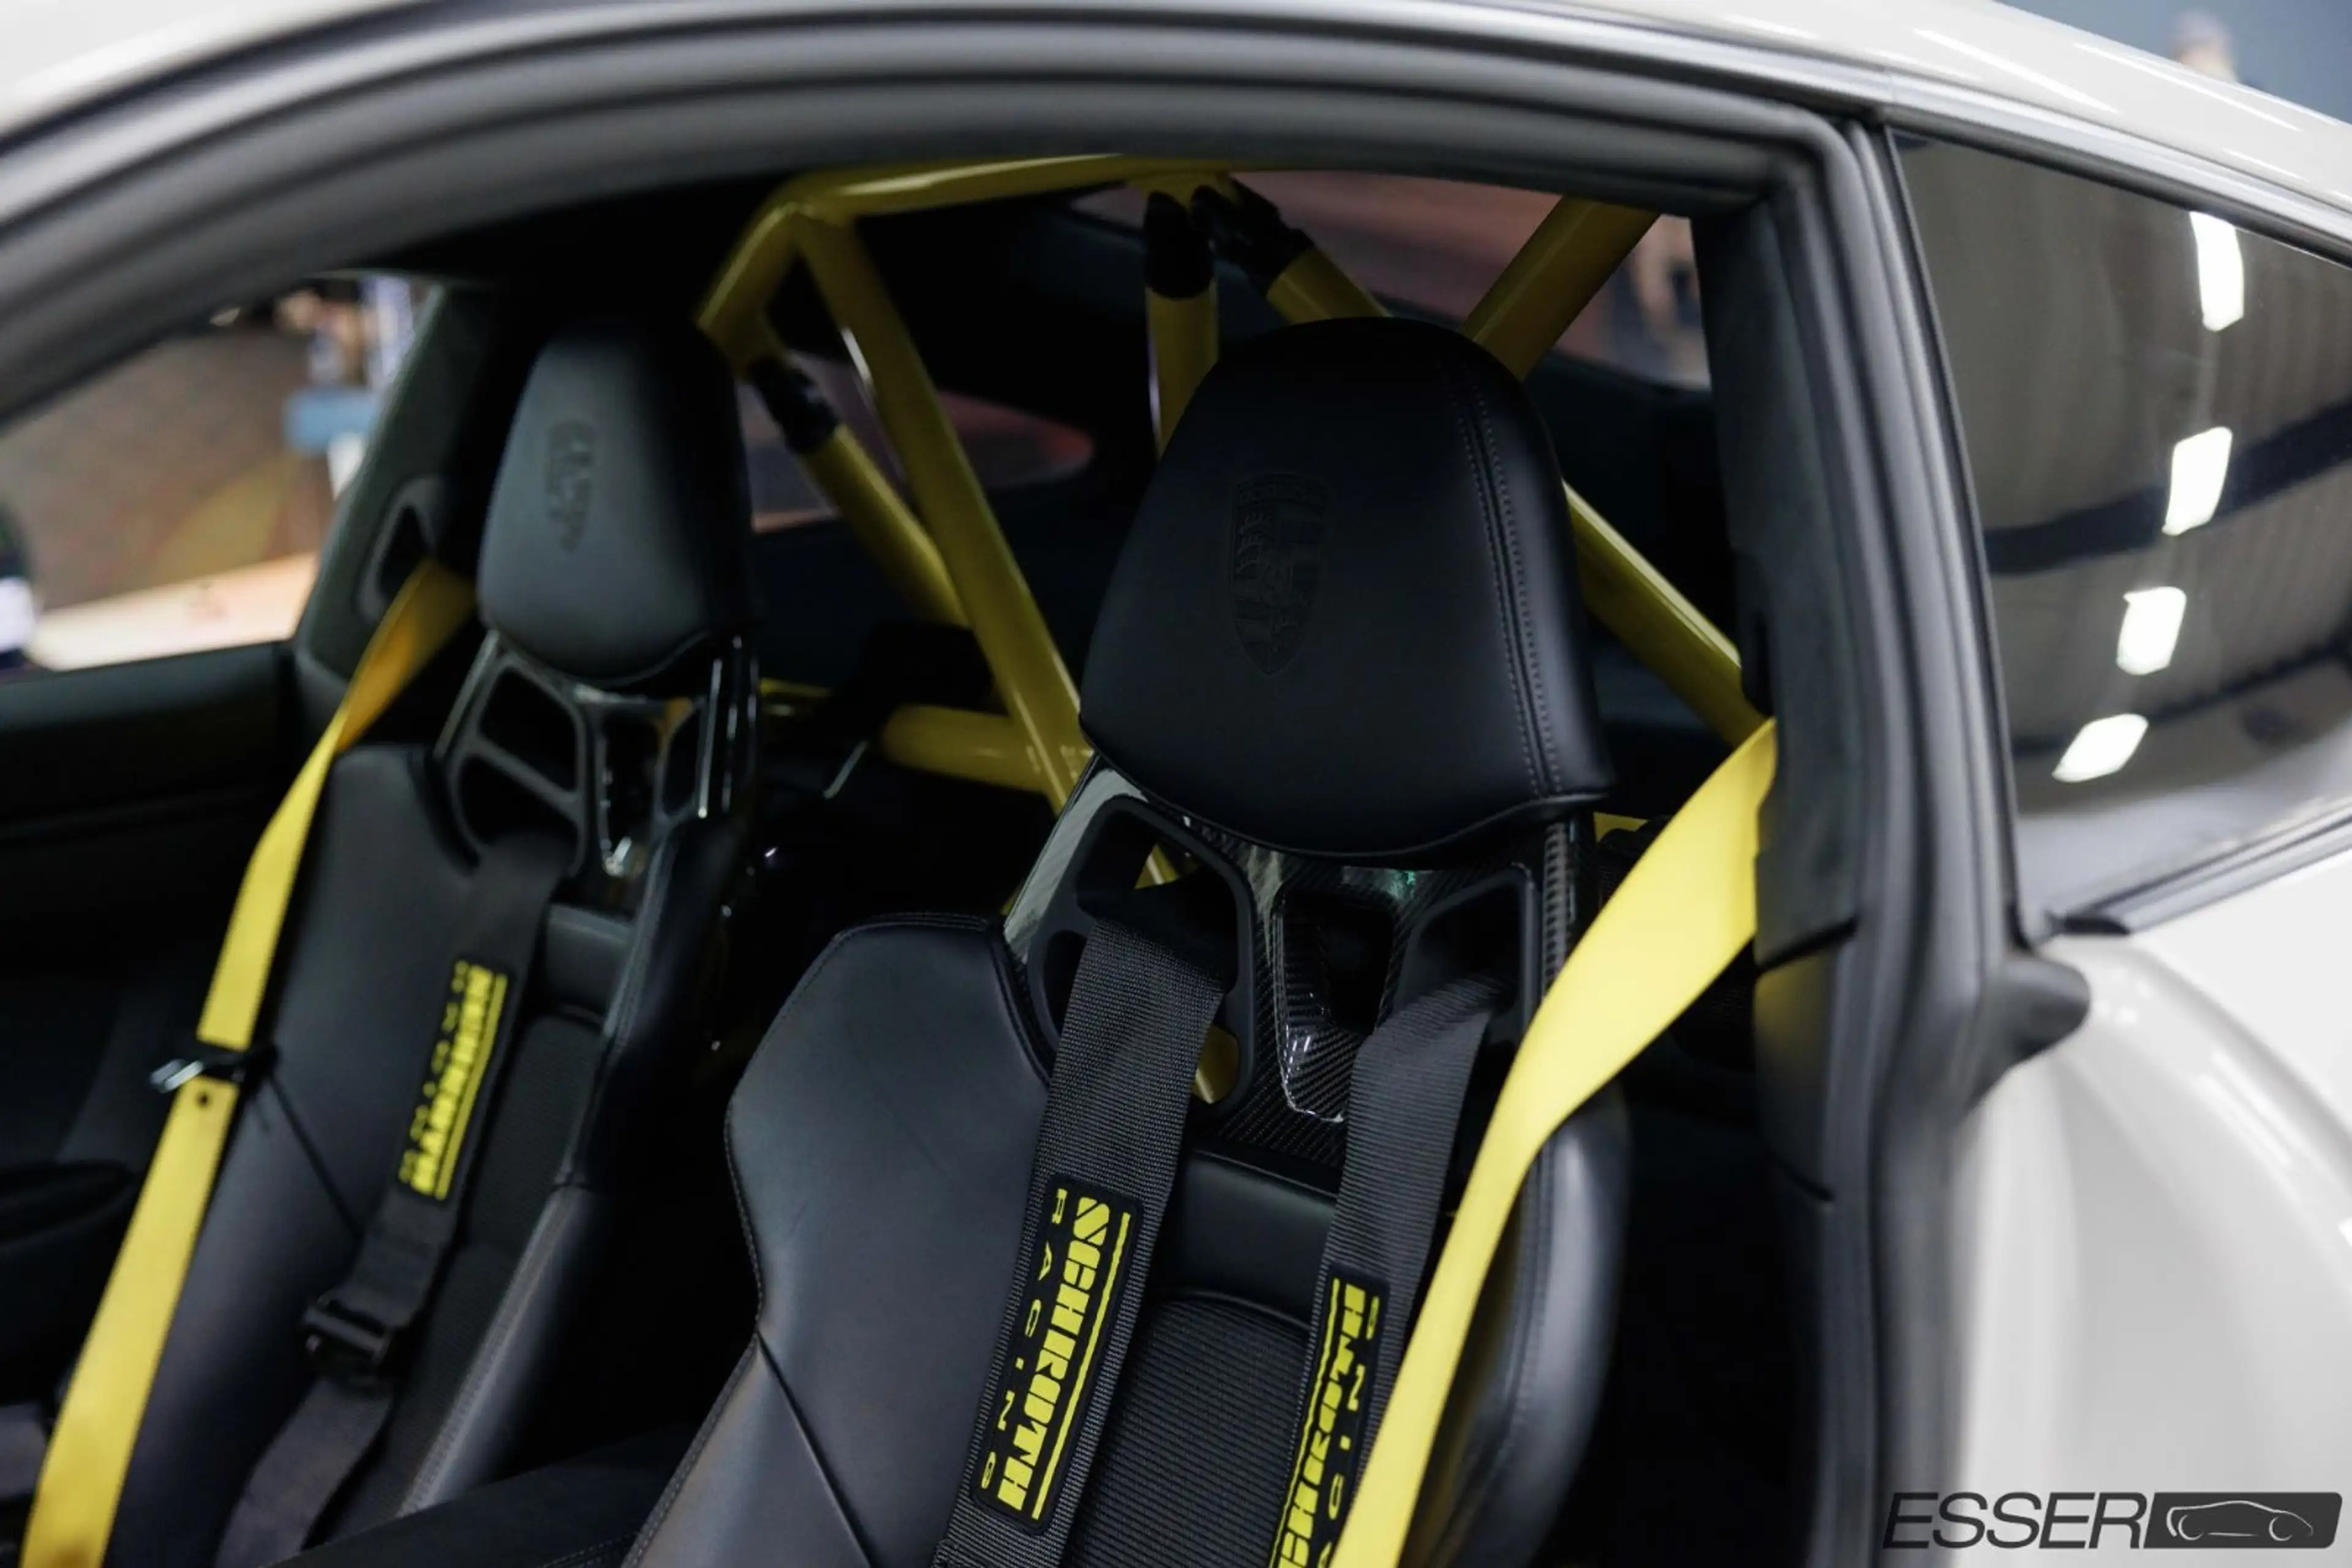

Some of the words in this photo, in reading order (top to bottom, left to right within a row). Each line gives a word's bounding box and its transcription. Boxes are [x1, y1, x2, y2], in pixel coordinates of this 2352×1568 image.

[981, 1188, 1067, 1488] RACING
[997, 1196, 1110, 1510] SCHROTH
[1277, 1284, 1365, 1568] CHROTH
